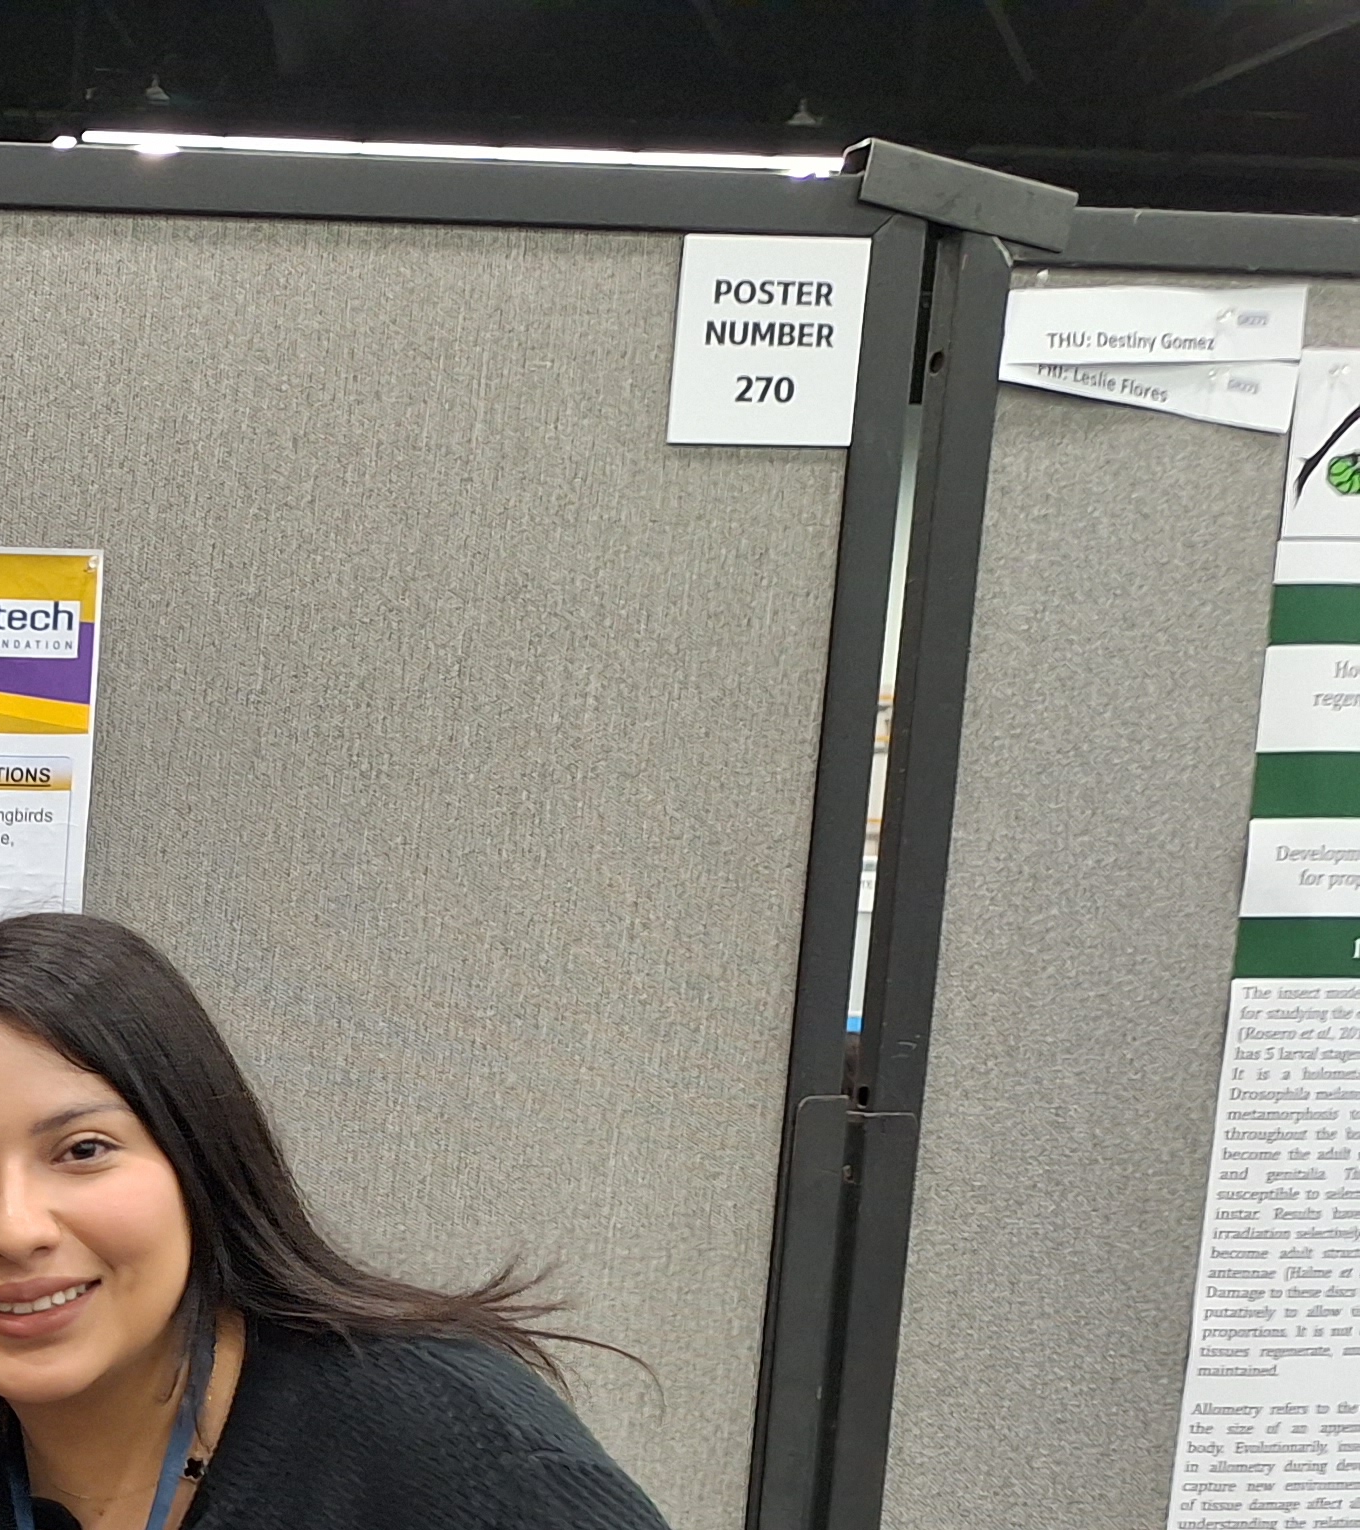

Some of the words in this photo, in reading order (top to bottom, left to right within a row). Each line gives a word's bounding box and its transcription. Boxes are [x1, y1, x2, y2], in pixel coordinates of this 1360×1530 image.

[714, 278, 834, 307] POSTER
[704, 319, 835, 348] NUMBER
[1046, 332, 1092, 350] THU:
[1096, 330, 1158, 353] Destiny
[1161, 332, 1216, 351] Gomez
[734, 374, 795, 404] 270
[1073, 366, 1118, 392] Leslie
[1120, 377, 1169, 404] Flores
